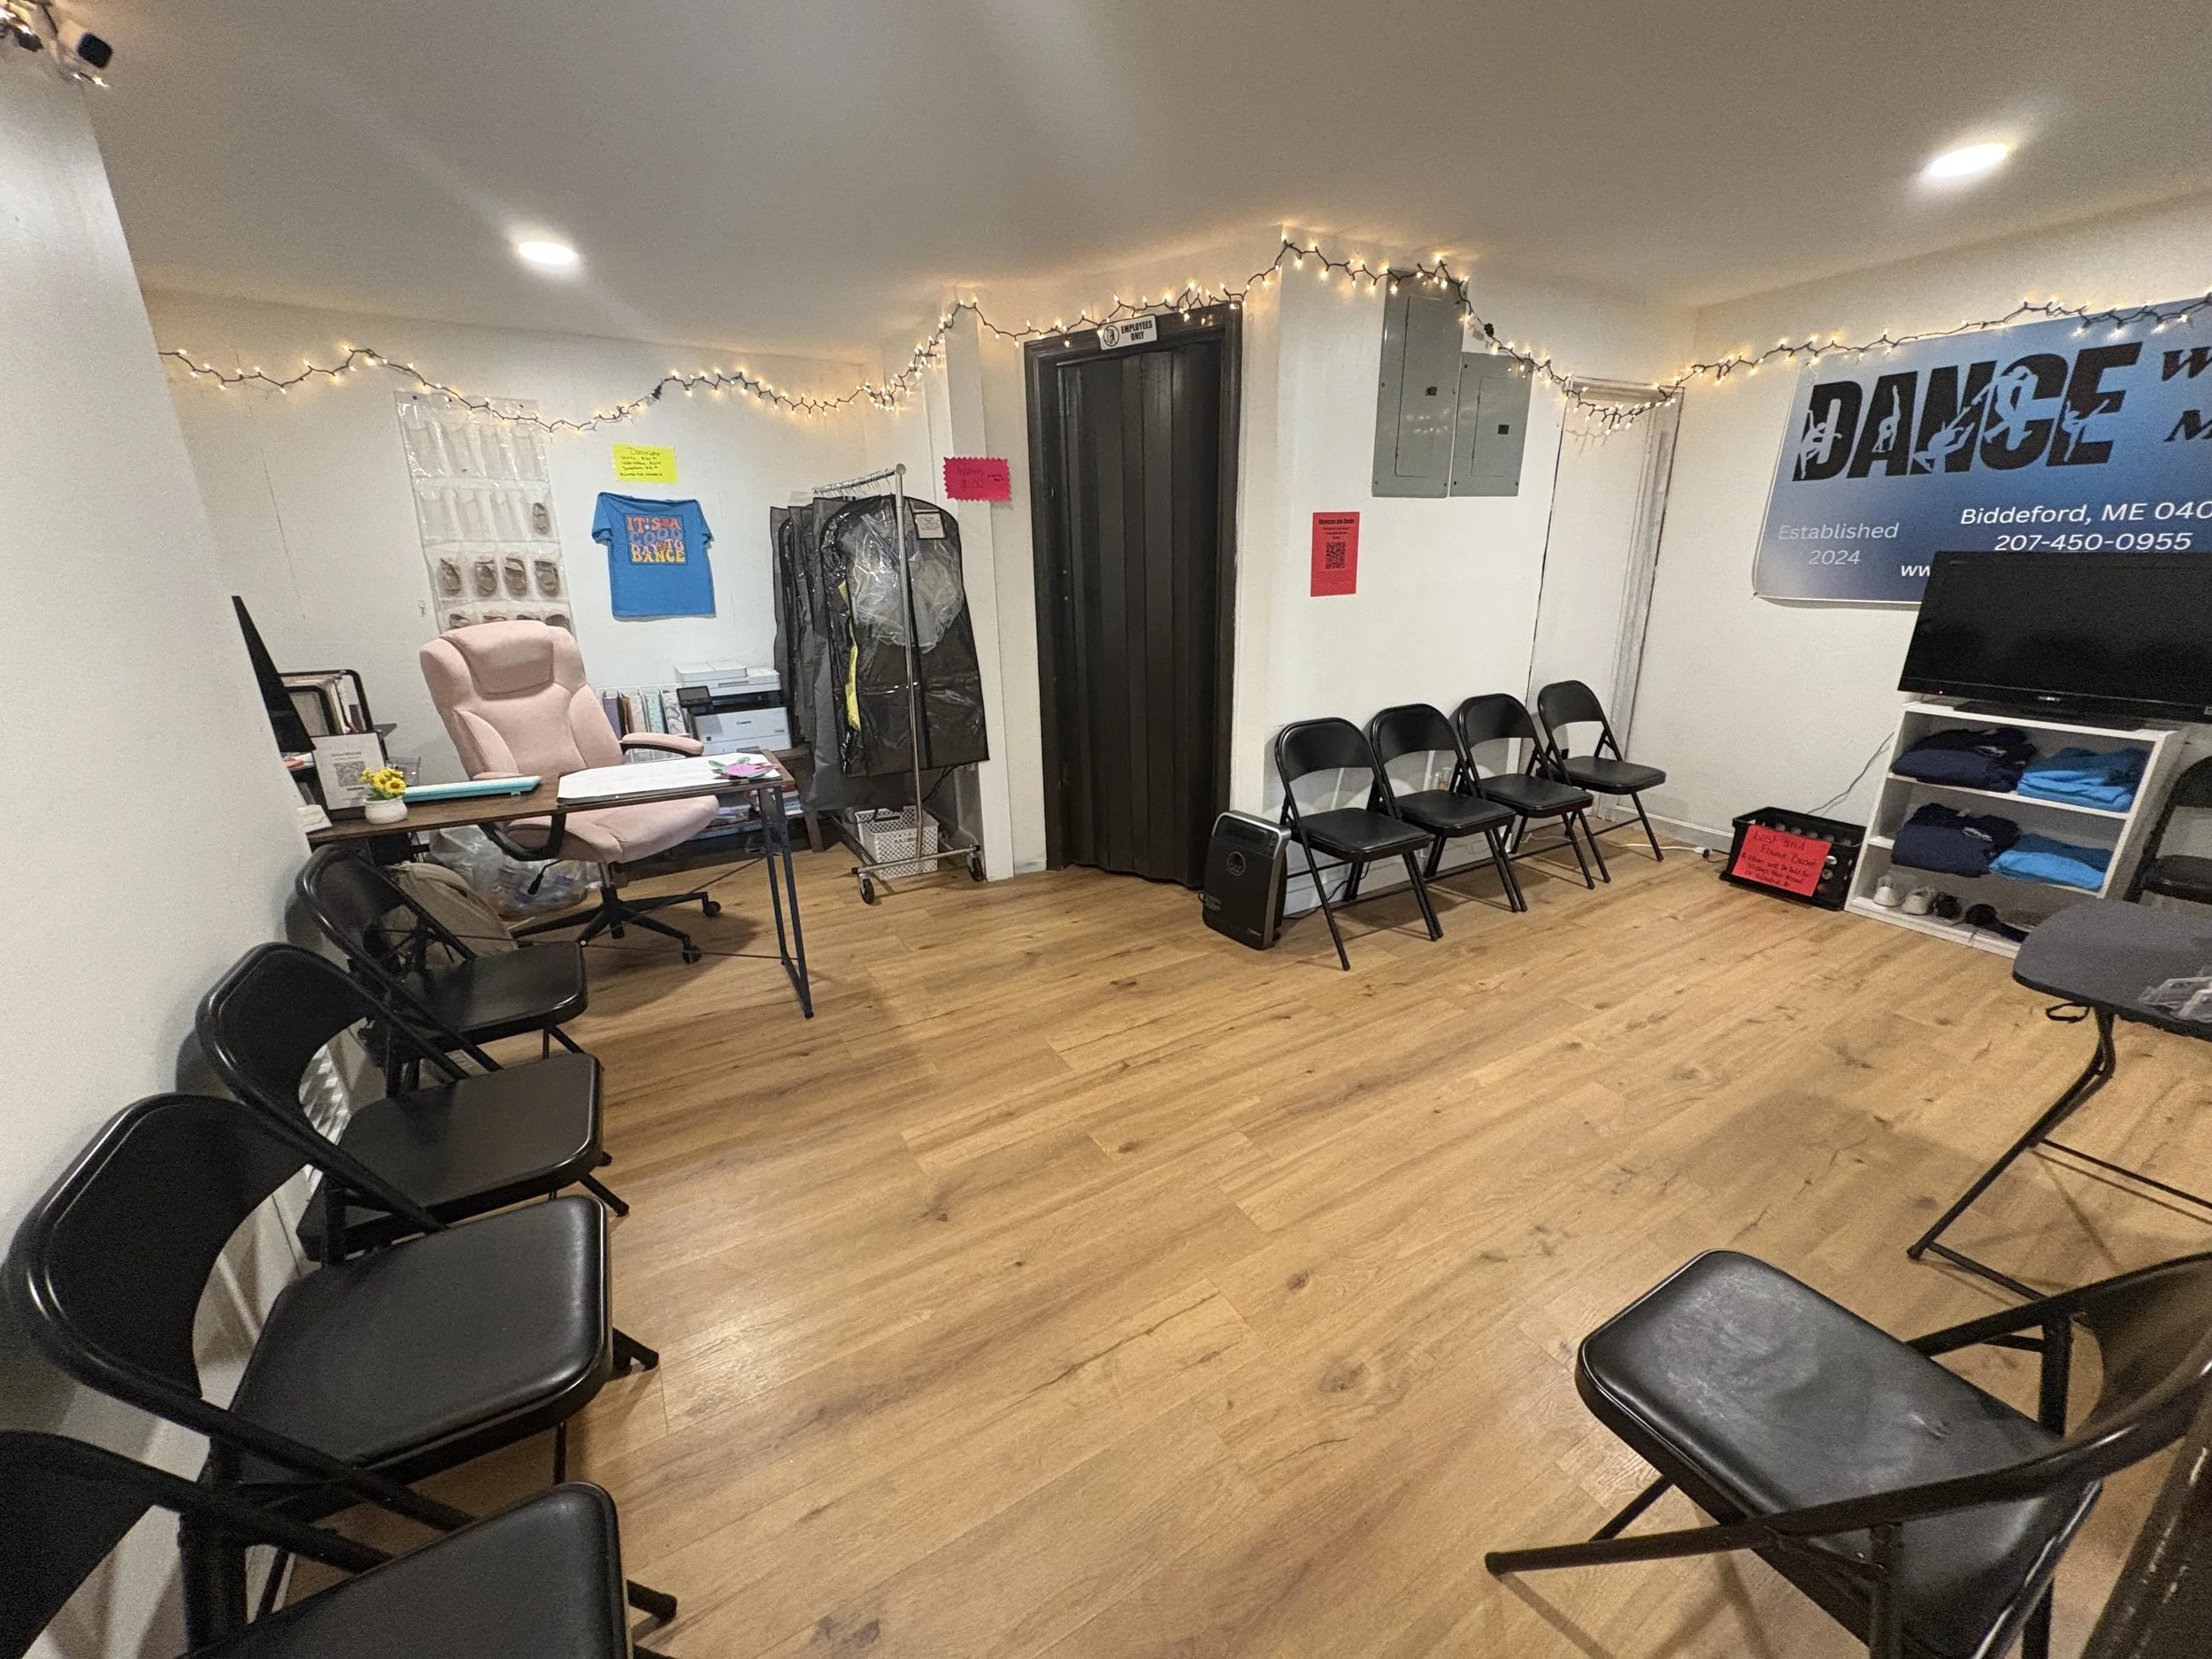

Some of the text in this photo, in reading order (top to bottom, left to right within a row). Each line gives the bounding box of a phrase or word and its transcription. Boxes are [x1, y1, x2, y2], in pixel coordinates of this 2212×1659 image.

[1121, 320, 1153, 334] EMPLOYEES
[1131, 331, 1144, 341] ONLY
[1792, 341, 2144, 482] DANCE
[1961, 504, 2092, 525] Biddeford,
[2101, 503, 2148, 521] ME
[626, 516, 681, 534] IT'S A
[1778, 523, 1900, 540] Established
[629, 527, 683, 546] GOOD
[1994, 533, 2193, 551] 207-450-0955
[629, 538, 685, 555] DAY TO
[632, 549, 686, 563] DANCE
[1809, 549, 1861, 565] 2024
[1754, 831, 1777, 844] Lost
